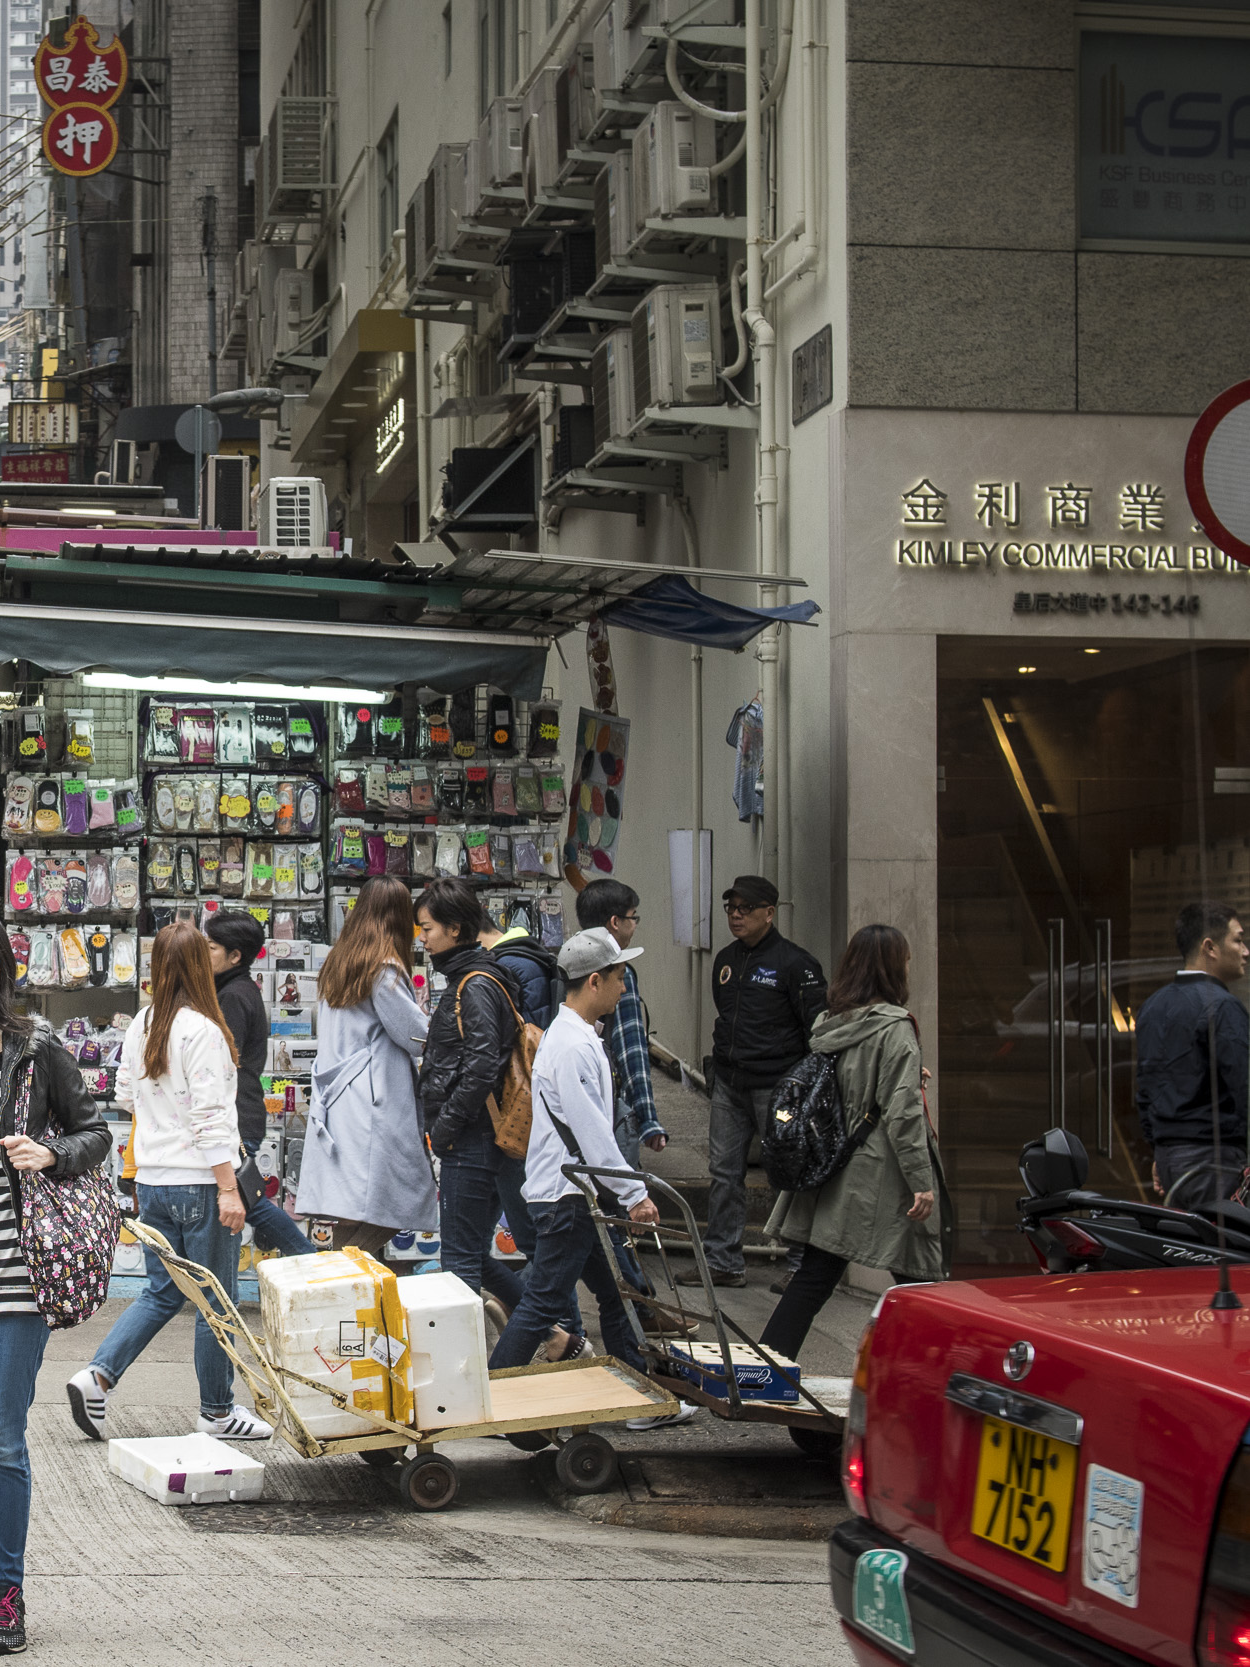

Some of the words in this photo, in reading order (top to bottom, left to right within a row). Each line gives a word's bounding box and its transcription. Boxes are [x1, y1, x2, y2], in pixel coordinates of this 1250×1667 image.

[45, 54, 119, 94] 昌泰
[55, 113, 103, 165] 押
[1100, 165, 1135, 182] KSF
[1139, 166, 1216, 186] Business
[902, 478, 1208, 533] 金利商業
[897, 539, 1000, 567] KIMLEY
[1002, 542, 1187, 571] COMMERCIAL
[1013, 591, 1108, 613] 皇后大道中
[341, 1344, 352, 1352] 6
[353, 1343, 363, 1352] A
[736, 1368, 773, 1384] Camila
[1006, 1428, 1049, 1497] NH
[985, 1480, 1055, 1563] 7152
